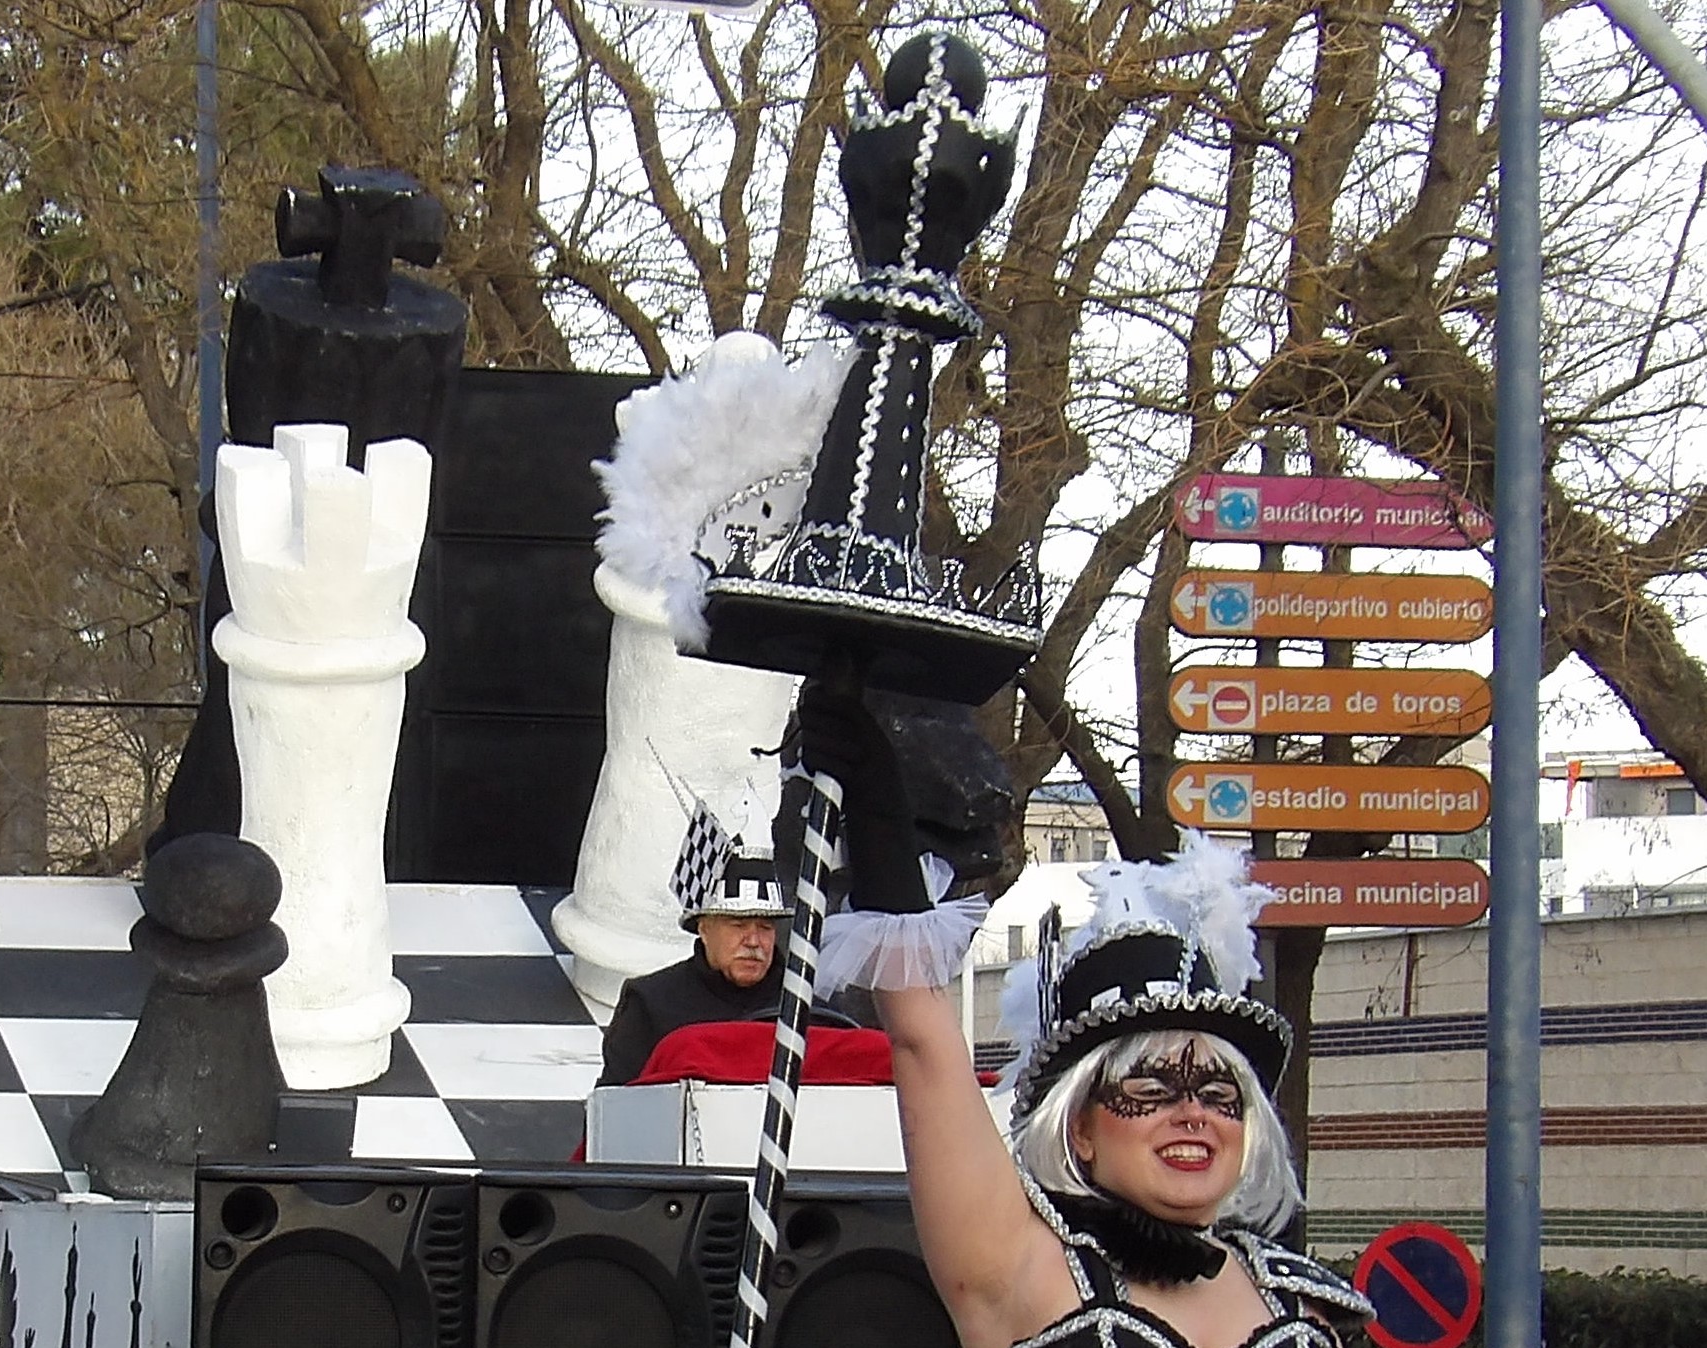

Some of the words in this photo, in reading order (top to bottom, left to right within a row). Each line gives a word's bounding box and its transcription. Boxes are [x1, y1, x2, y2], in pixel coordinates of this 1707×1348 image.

[1262, 502, 1364, 524] auditorio
[1254, 594, 1389, 622] polideportivo
[1398, 597, 1483, 621] cubierto
[1261, 690, 1331, 717] plaza
[1345, 691, 1378, 713] de
[1393, 692, 1462, 714] toros
[1252, 786, 1347, 809] estadio
[1359, 788, 1480, 816] municipal
[1266, 881, 1342, 904] scina
[1356, 881, 1480, 910] municipal
